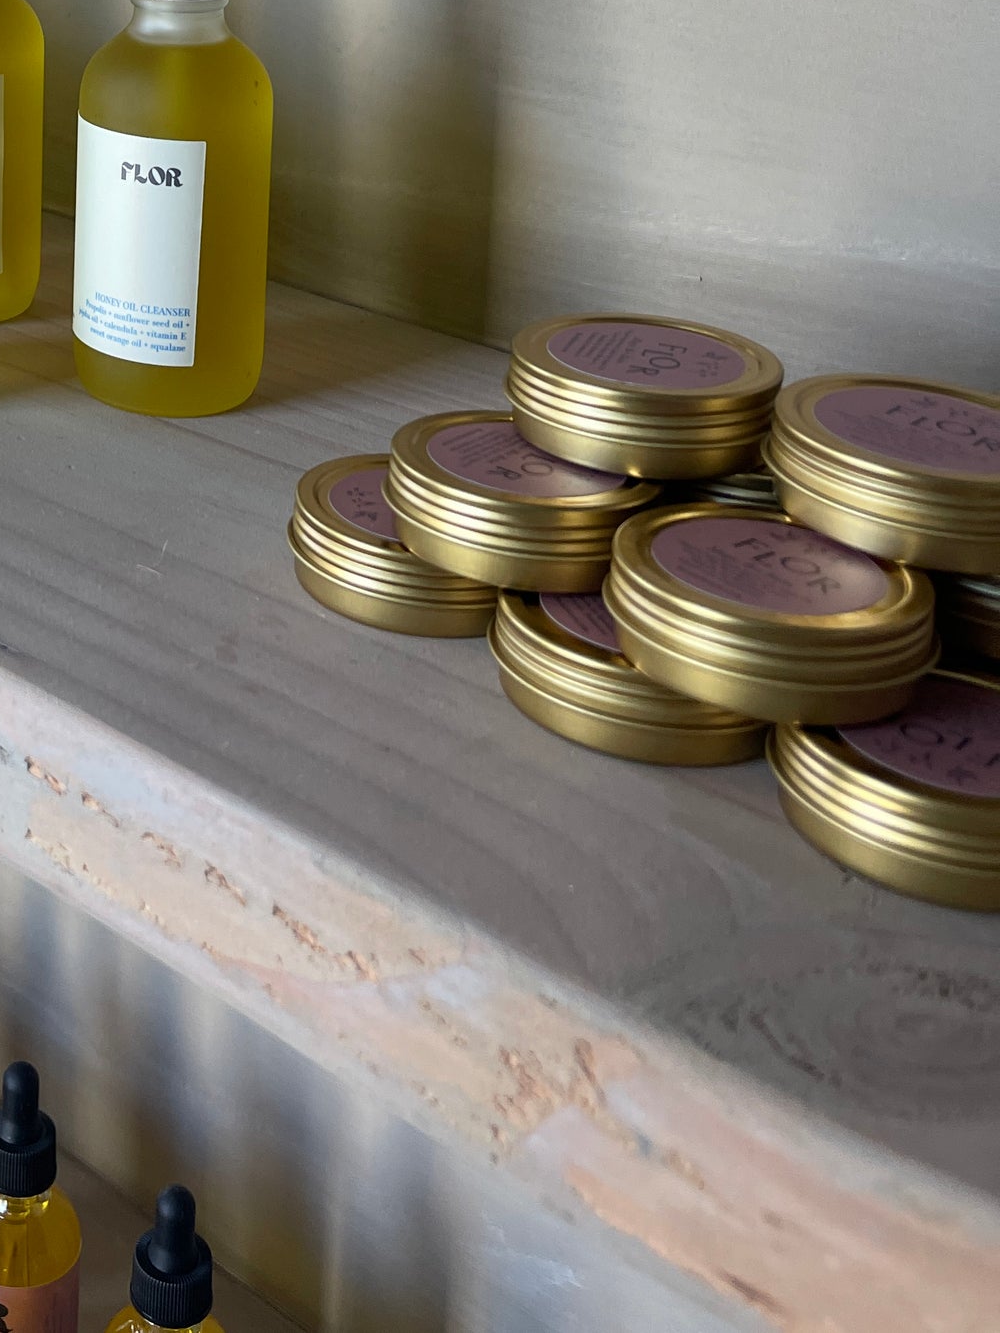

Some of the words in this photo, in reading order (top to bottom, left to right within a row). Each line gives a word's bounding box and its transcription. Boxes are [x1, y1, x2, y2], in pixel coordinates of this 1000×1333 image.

[121, 161, 183, 188] FLOR
[95, 292, 121, 308] HONEY
[122, 301, 138, 312] OIL
[140, 304, 191, 317] CLEANSER
[152, 319, 170, 328] seed
[172, 320, 183, 329] oil
[146, 330, 178, 340] vitamin
[180, 331, 187, 341] E
[150, 342, 186, 353] squalane
